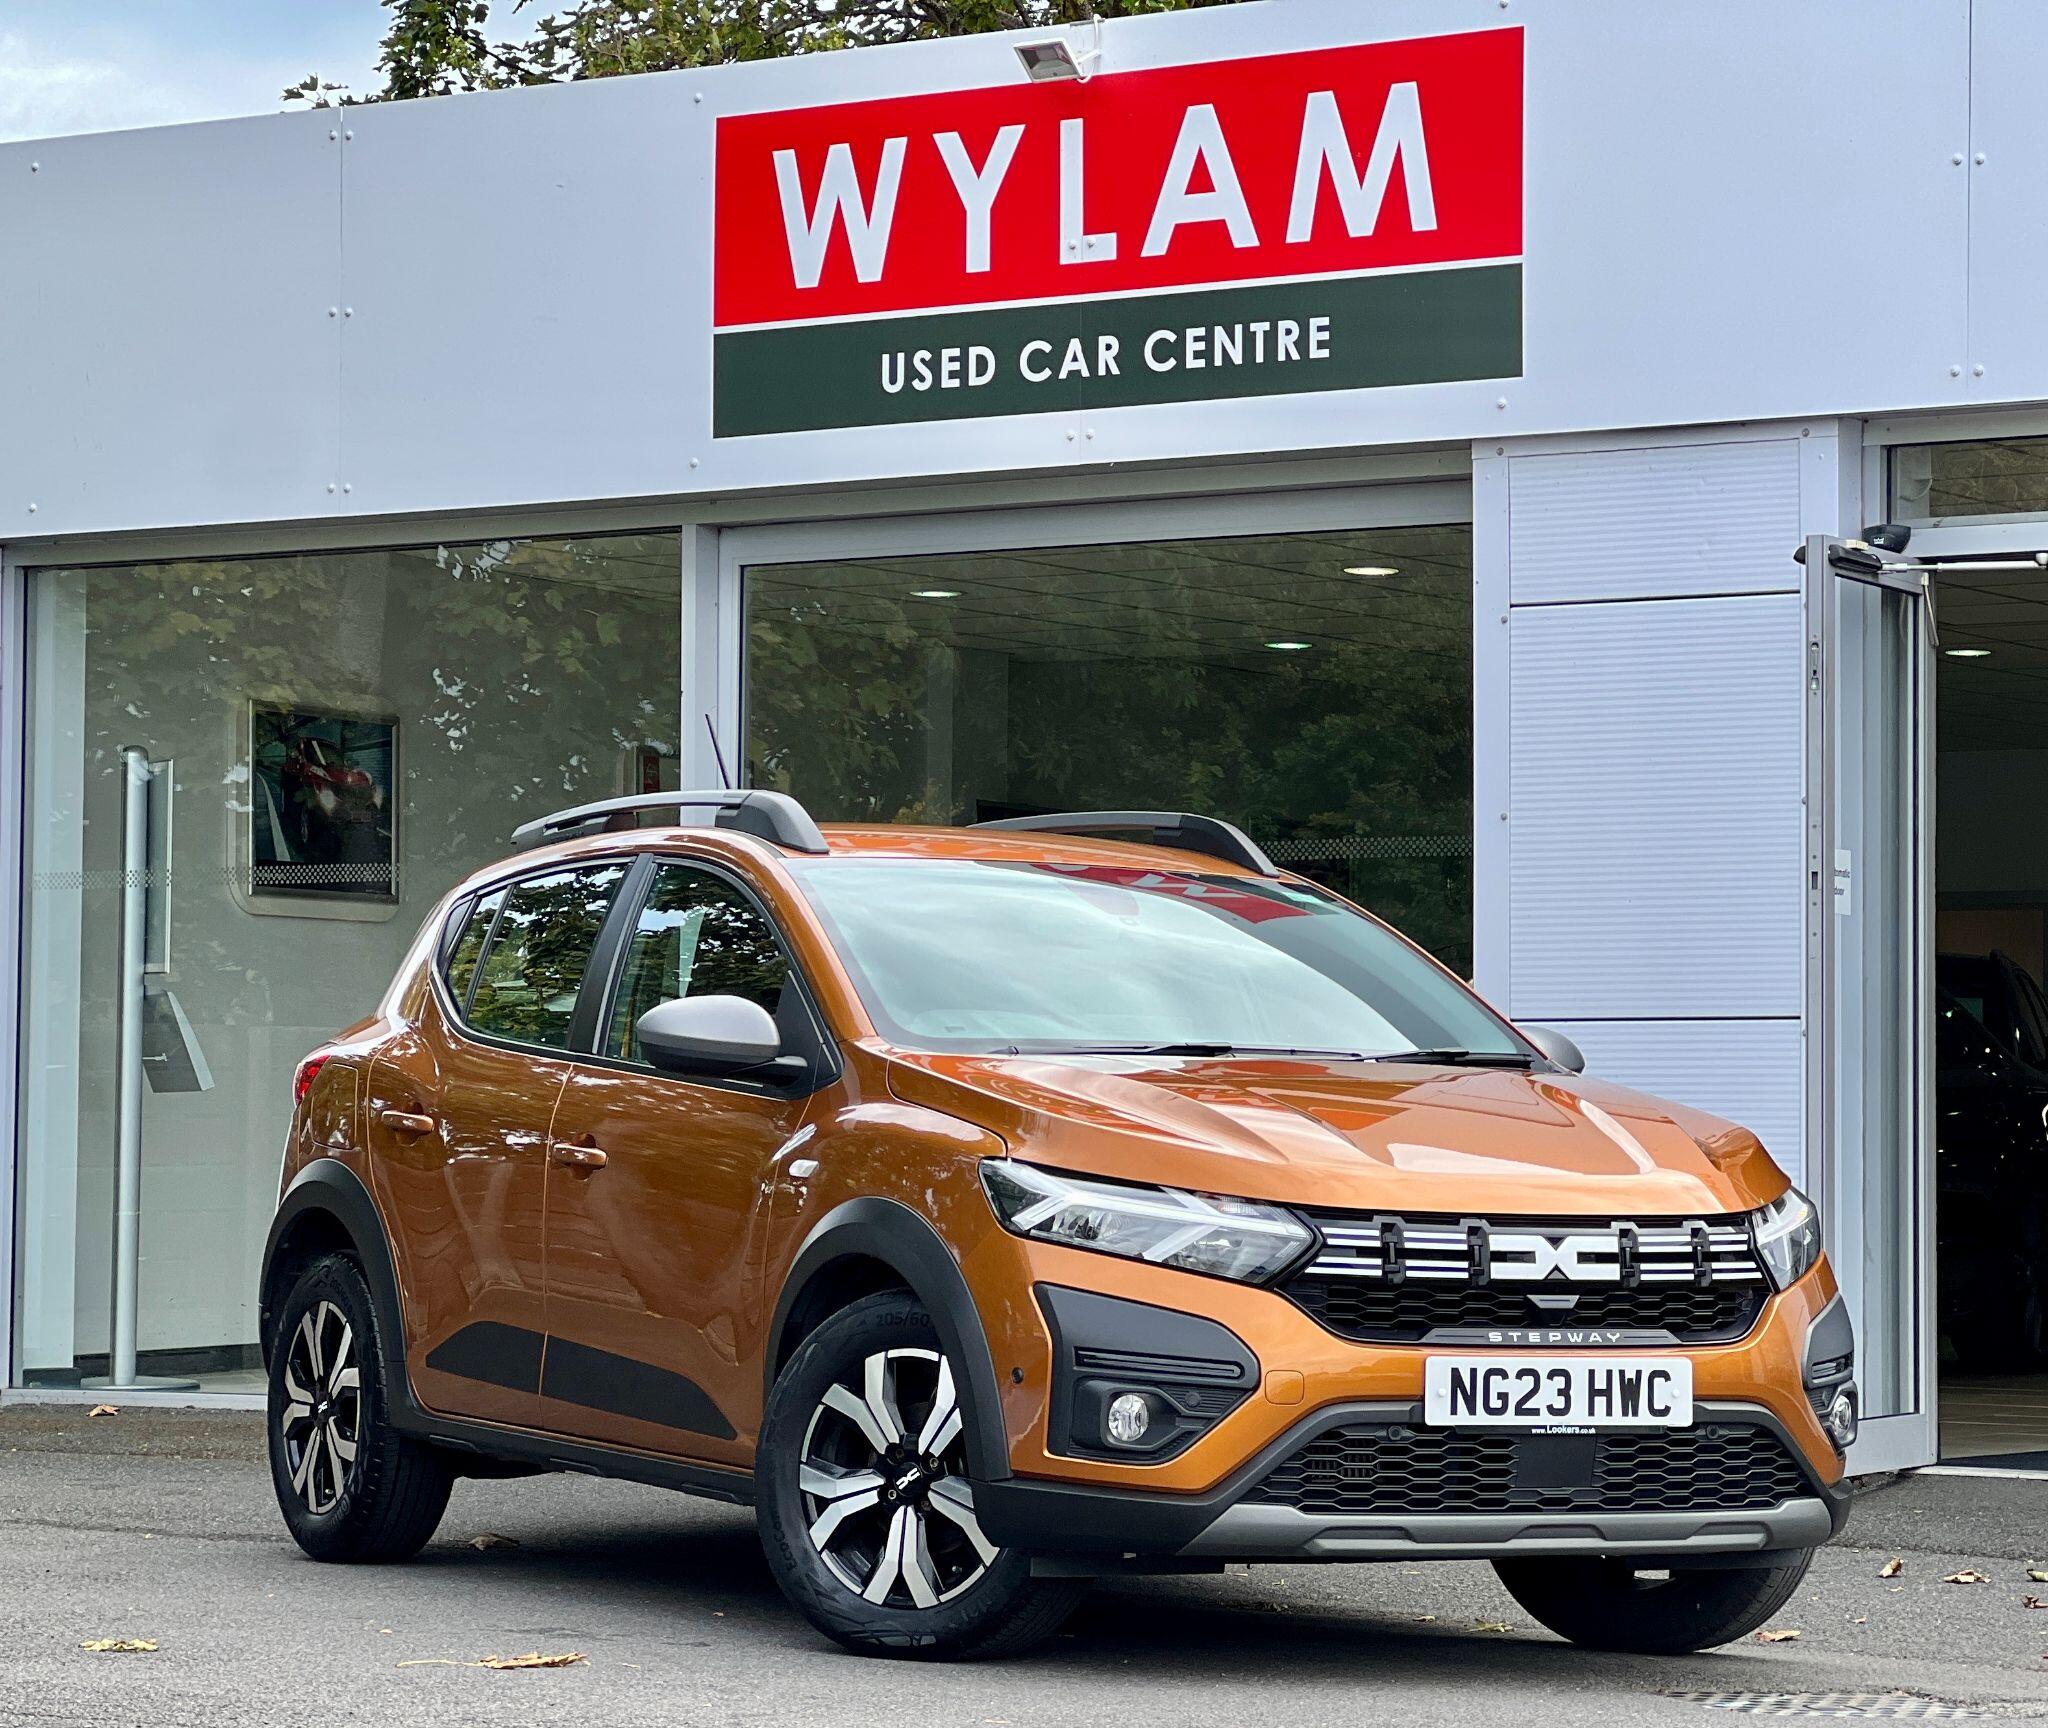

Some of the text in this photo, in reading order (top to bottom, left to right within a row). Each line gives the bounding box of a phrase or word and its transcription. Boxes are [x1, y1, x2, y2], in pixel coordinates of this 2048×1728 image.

[772, 81, 1438, 289] WYLAM
[880, 316, 1331, 394] USED CAR CENTRE
[1488, 1331, 1622, 1343] STEPWAY
[1450, 1367, 1672, 1418] NG23 HWC
